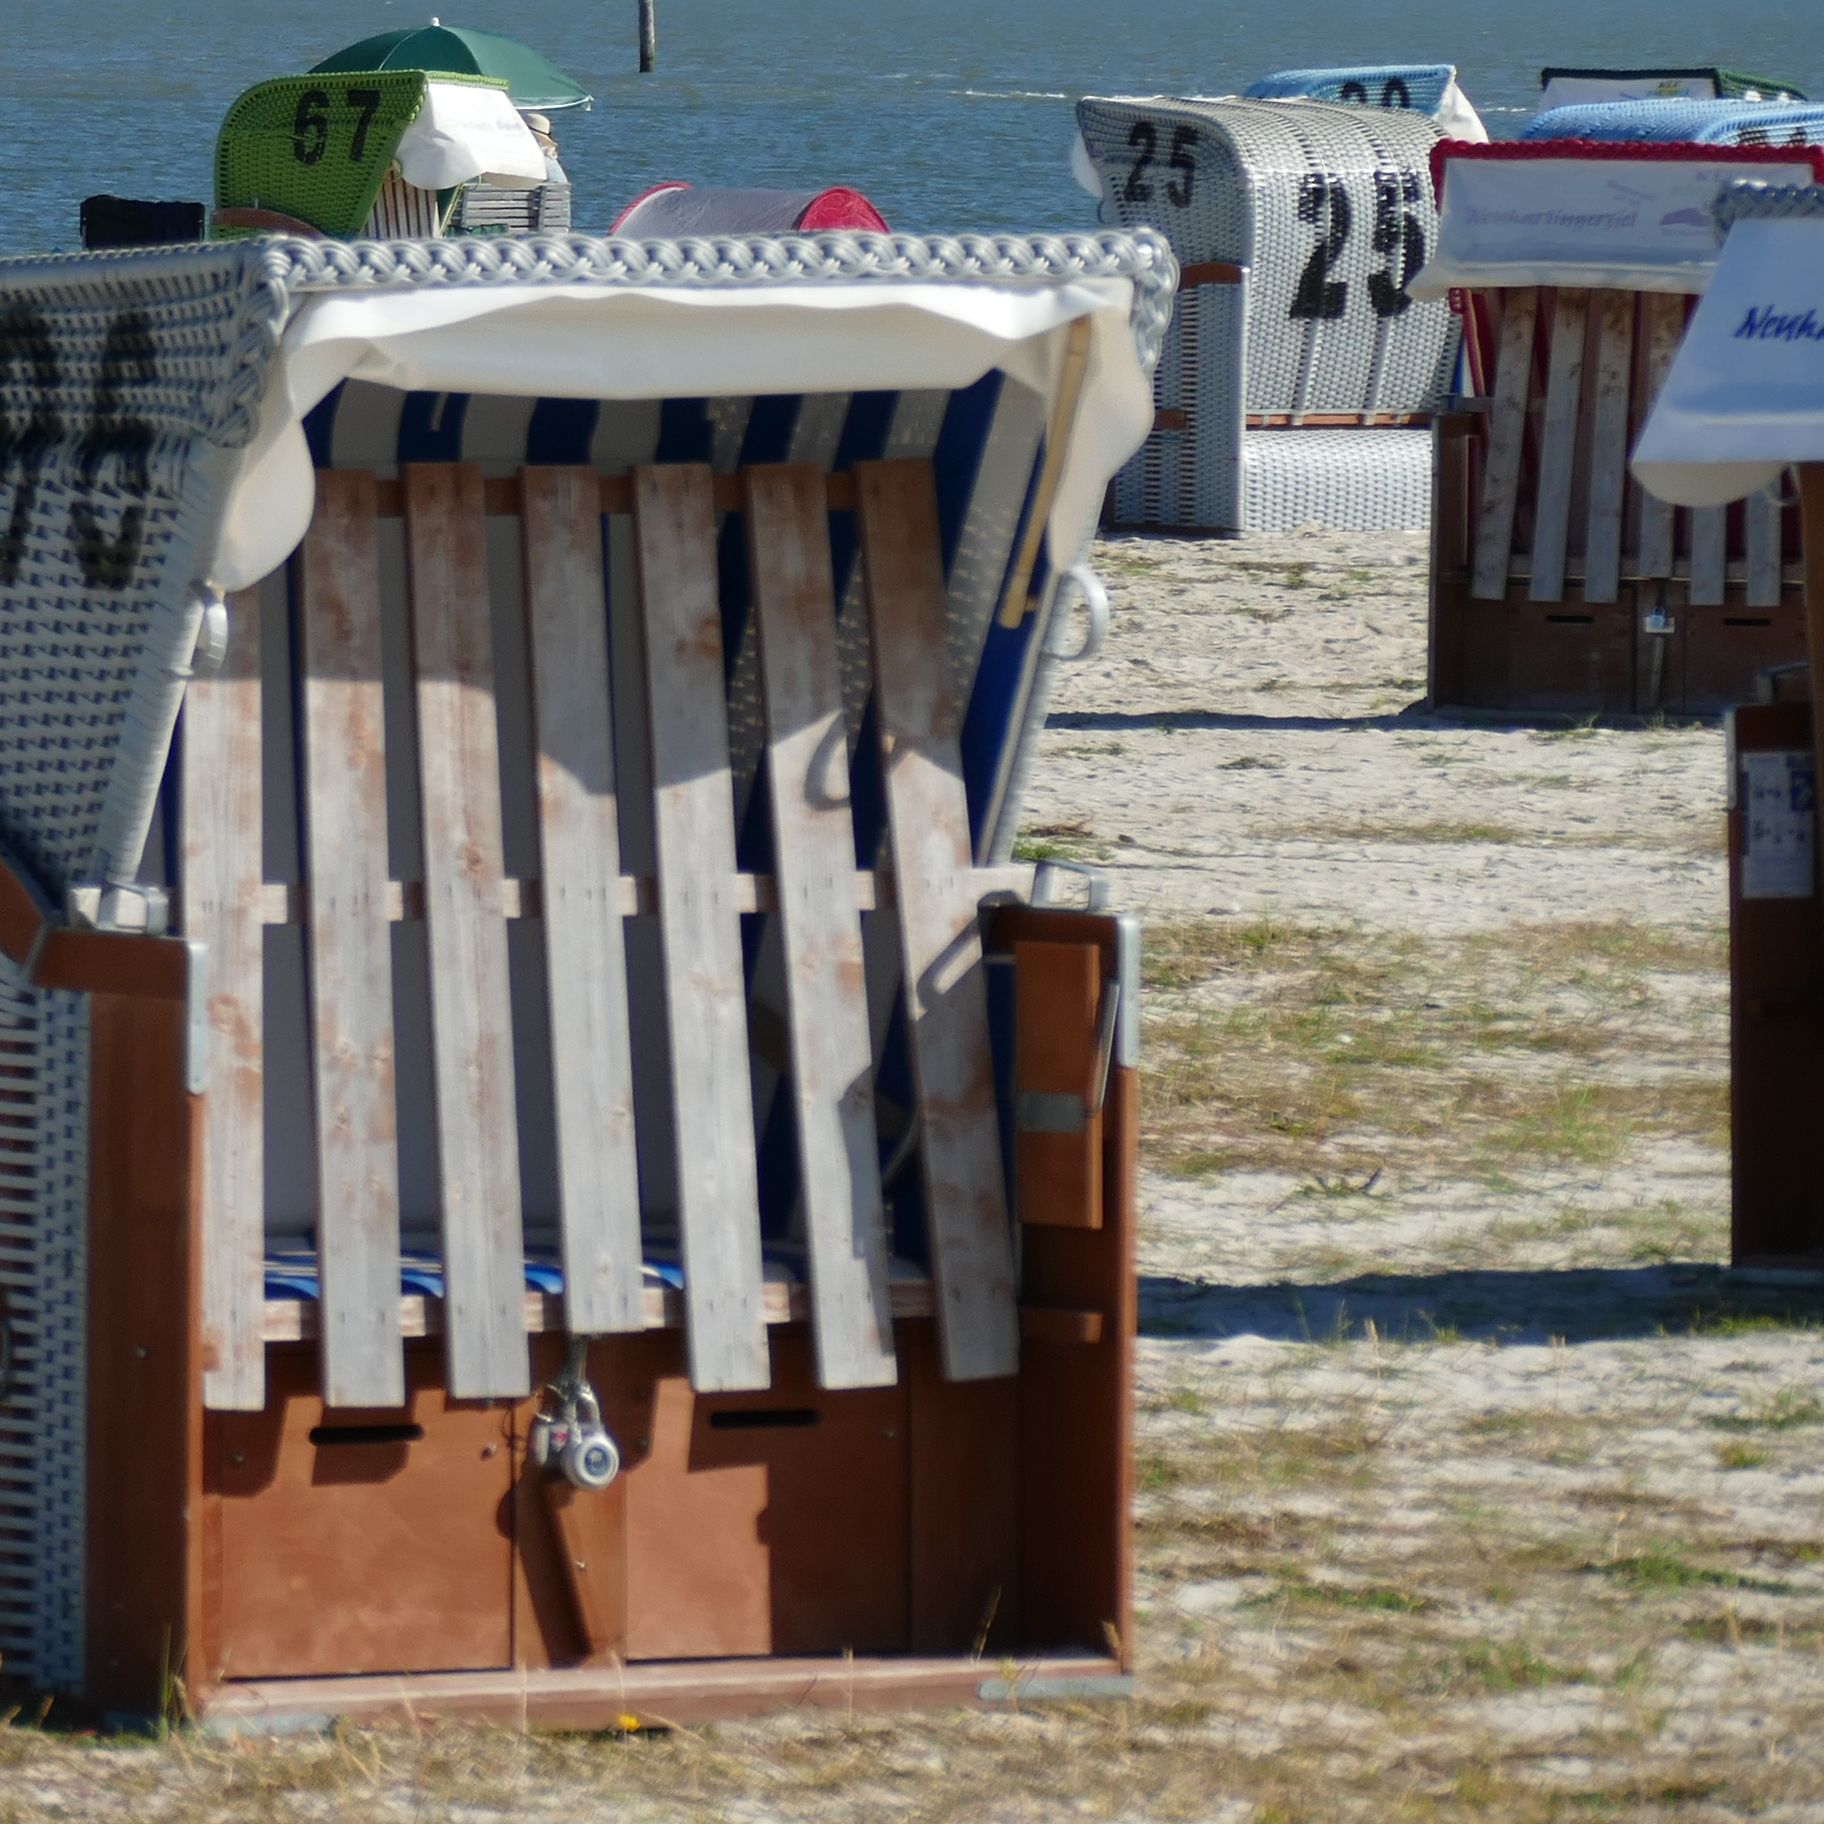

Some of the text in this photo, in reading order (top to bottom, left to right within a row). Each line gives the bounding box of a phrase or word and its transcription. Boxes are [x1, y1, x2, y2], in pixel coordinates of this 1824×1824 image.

[294, 90, 381, 165] 67
[1123, 122, 1199, 208] 25
[1289, 172, 1425, 319] 25
